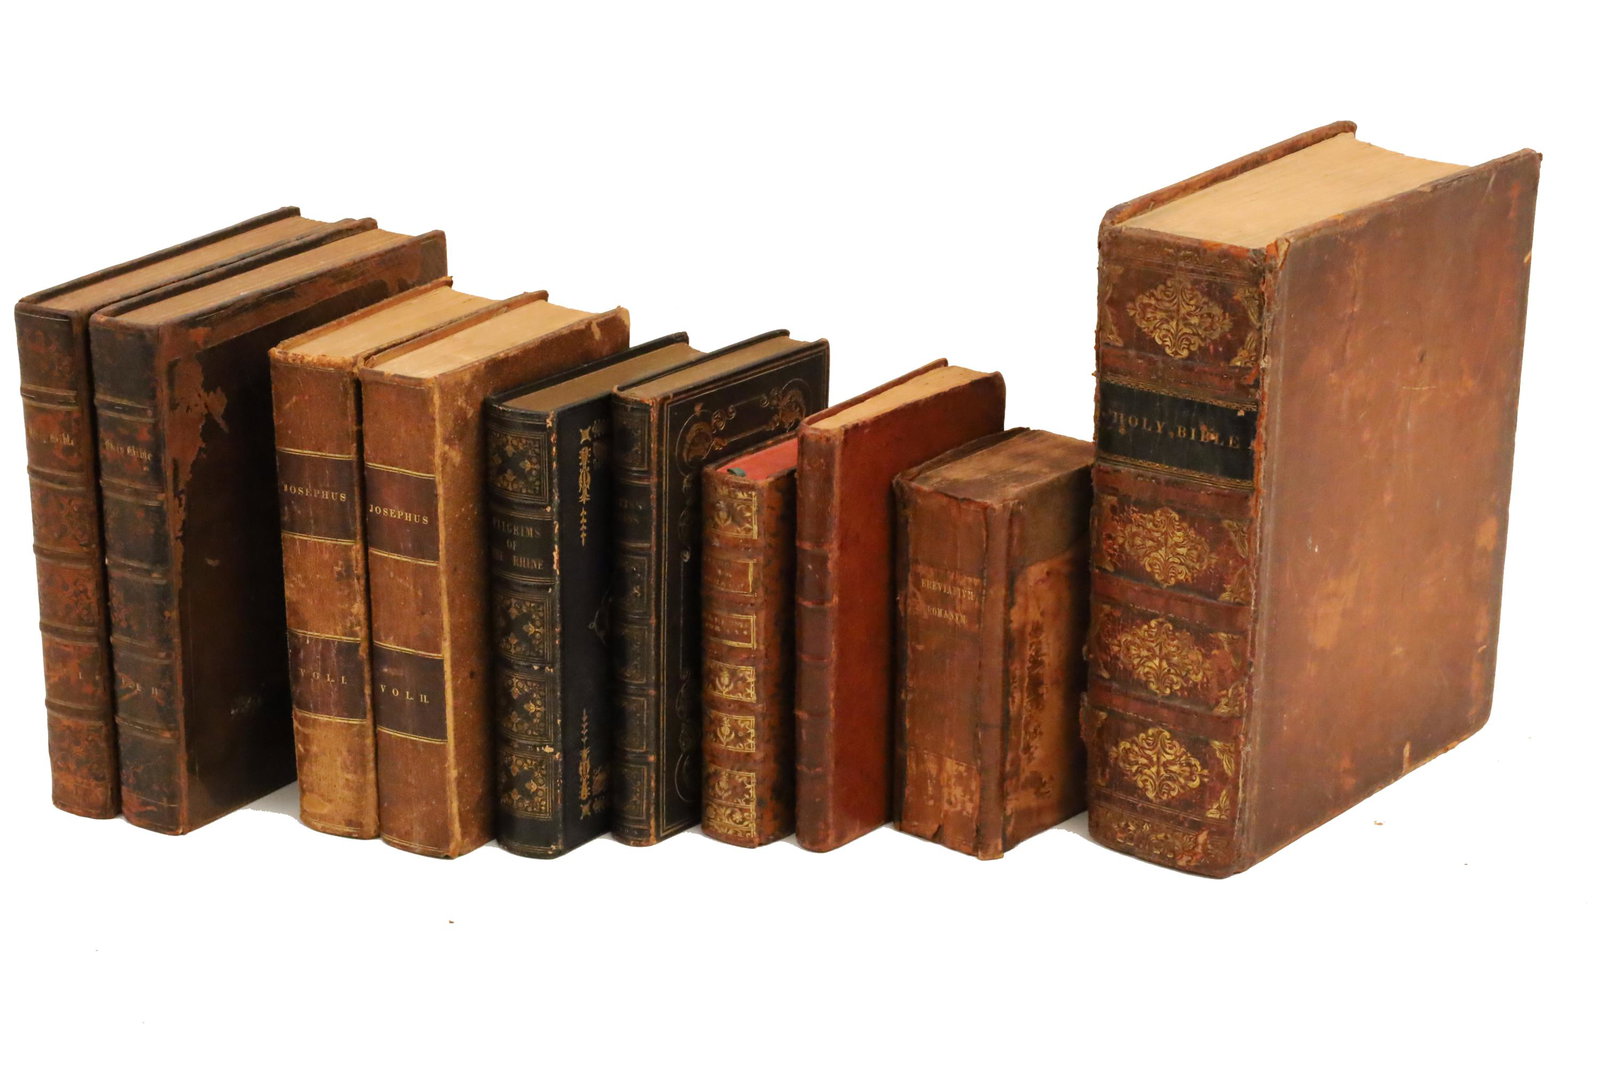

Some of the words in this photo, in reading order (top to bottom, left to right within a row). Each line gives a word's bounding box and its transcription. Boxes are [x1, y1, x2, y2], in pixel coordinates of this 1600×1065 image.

[1111, 410, 1165, 434] HOLY
[1176, 425, 1240, 449] BIBLE
[282, 483, 348, 503] JOSEPHUS
[368, 503, 430, 525] JOSEPHUS
[513, 555, 544, 570] RHINE
